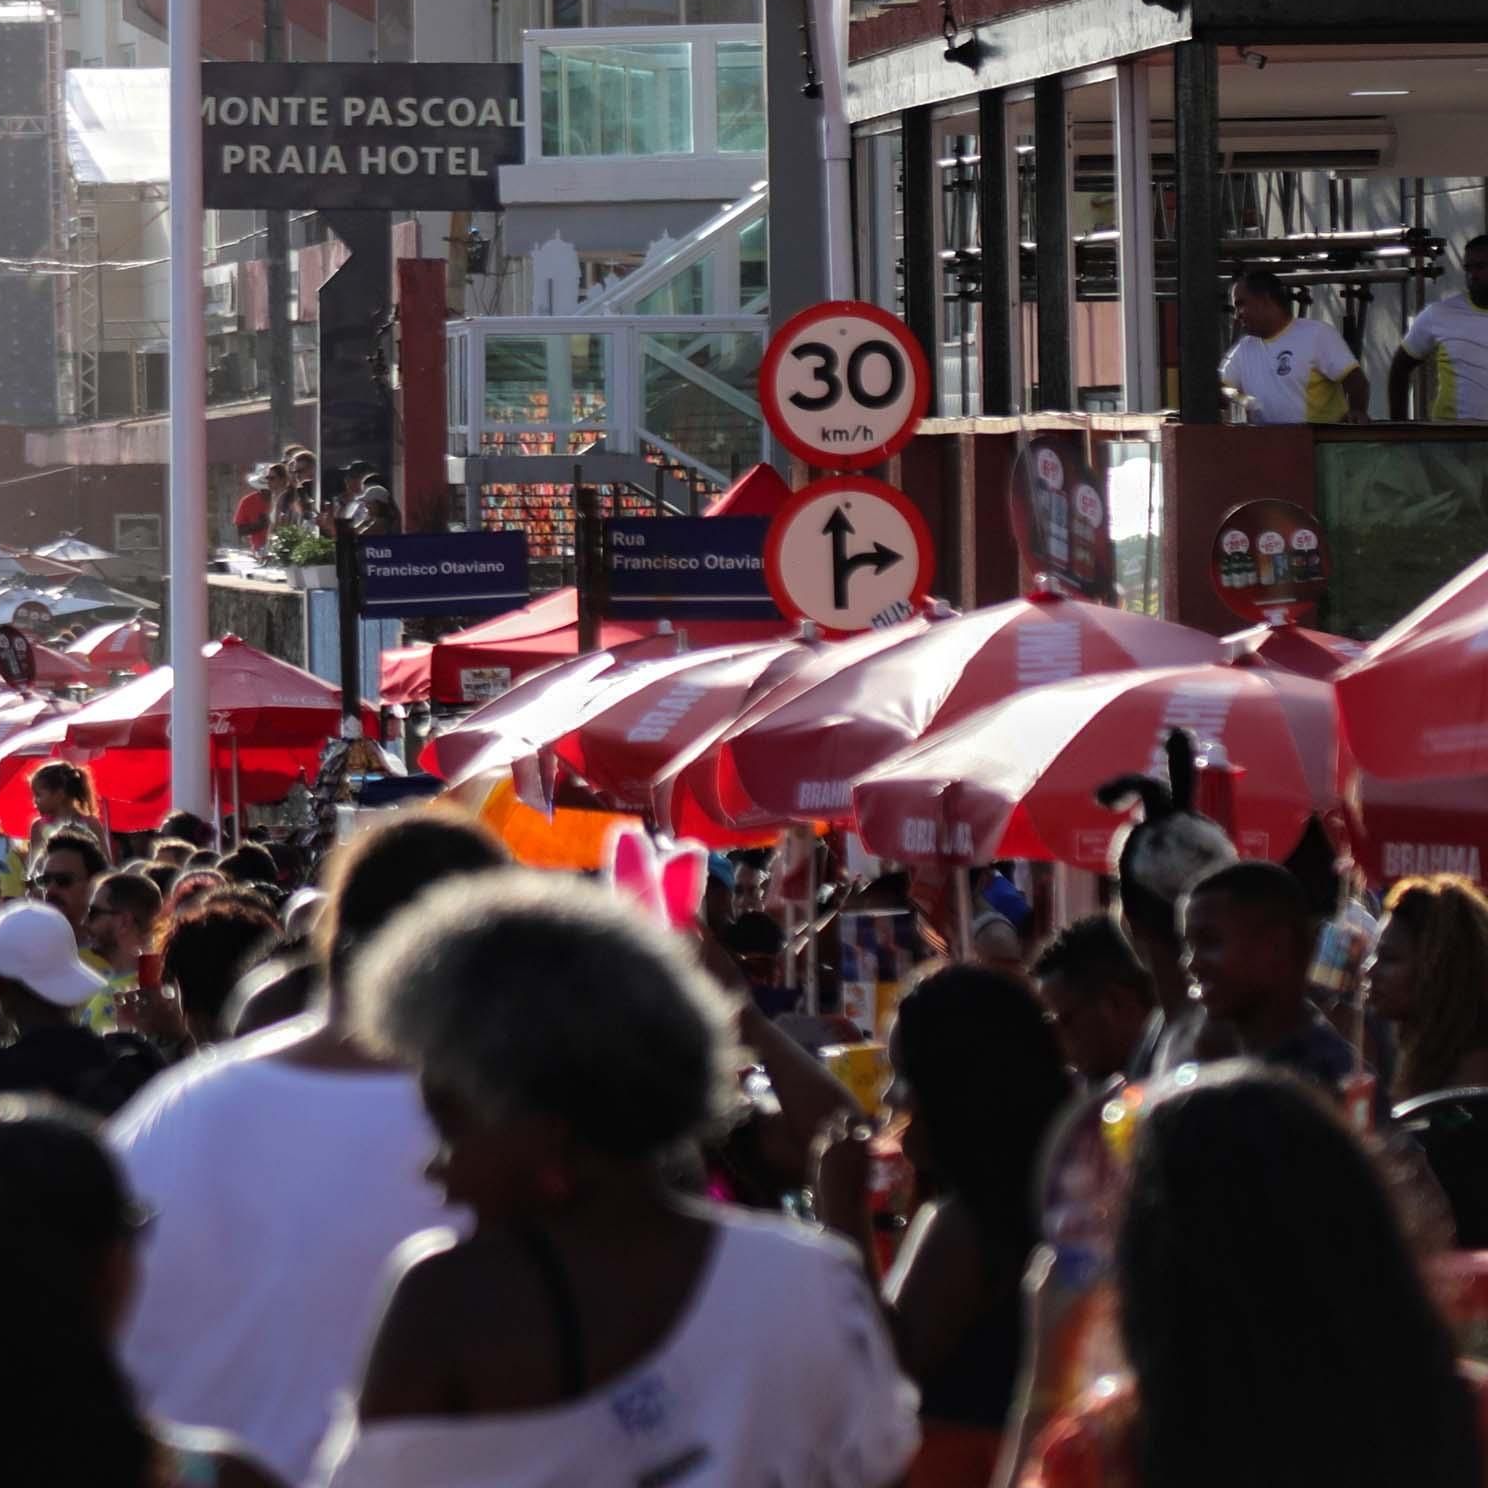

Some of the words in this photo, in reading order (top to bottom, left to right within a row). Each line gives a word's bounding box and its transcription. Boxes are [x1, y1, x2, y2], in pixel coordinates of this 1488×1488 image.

[343, 96, 525, 129] PASCOAL
[222, 144, 346, 175] PRAIA
[360, 145, 489, 177] HOTEL
[790, 340, 906, 411] 30
[821, 425, 874, 442] km/h
[612, 532, 646, 546] Rua
[365, 547, 393, 559] Rua
[367, 564, 438, 577] Francisco
[440, 561, 505, 575] Otaviano
[612, 554, 700, 570] Francisco
[704, 554, 765, 570] Otavia
[1382, 841, 1482, 881] BRAHMA
